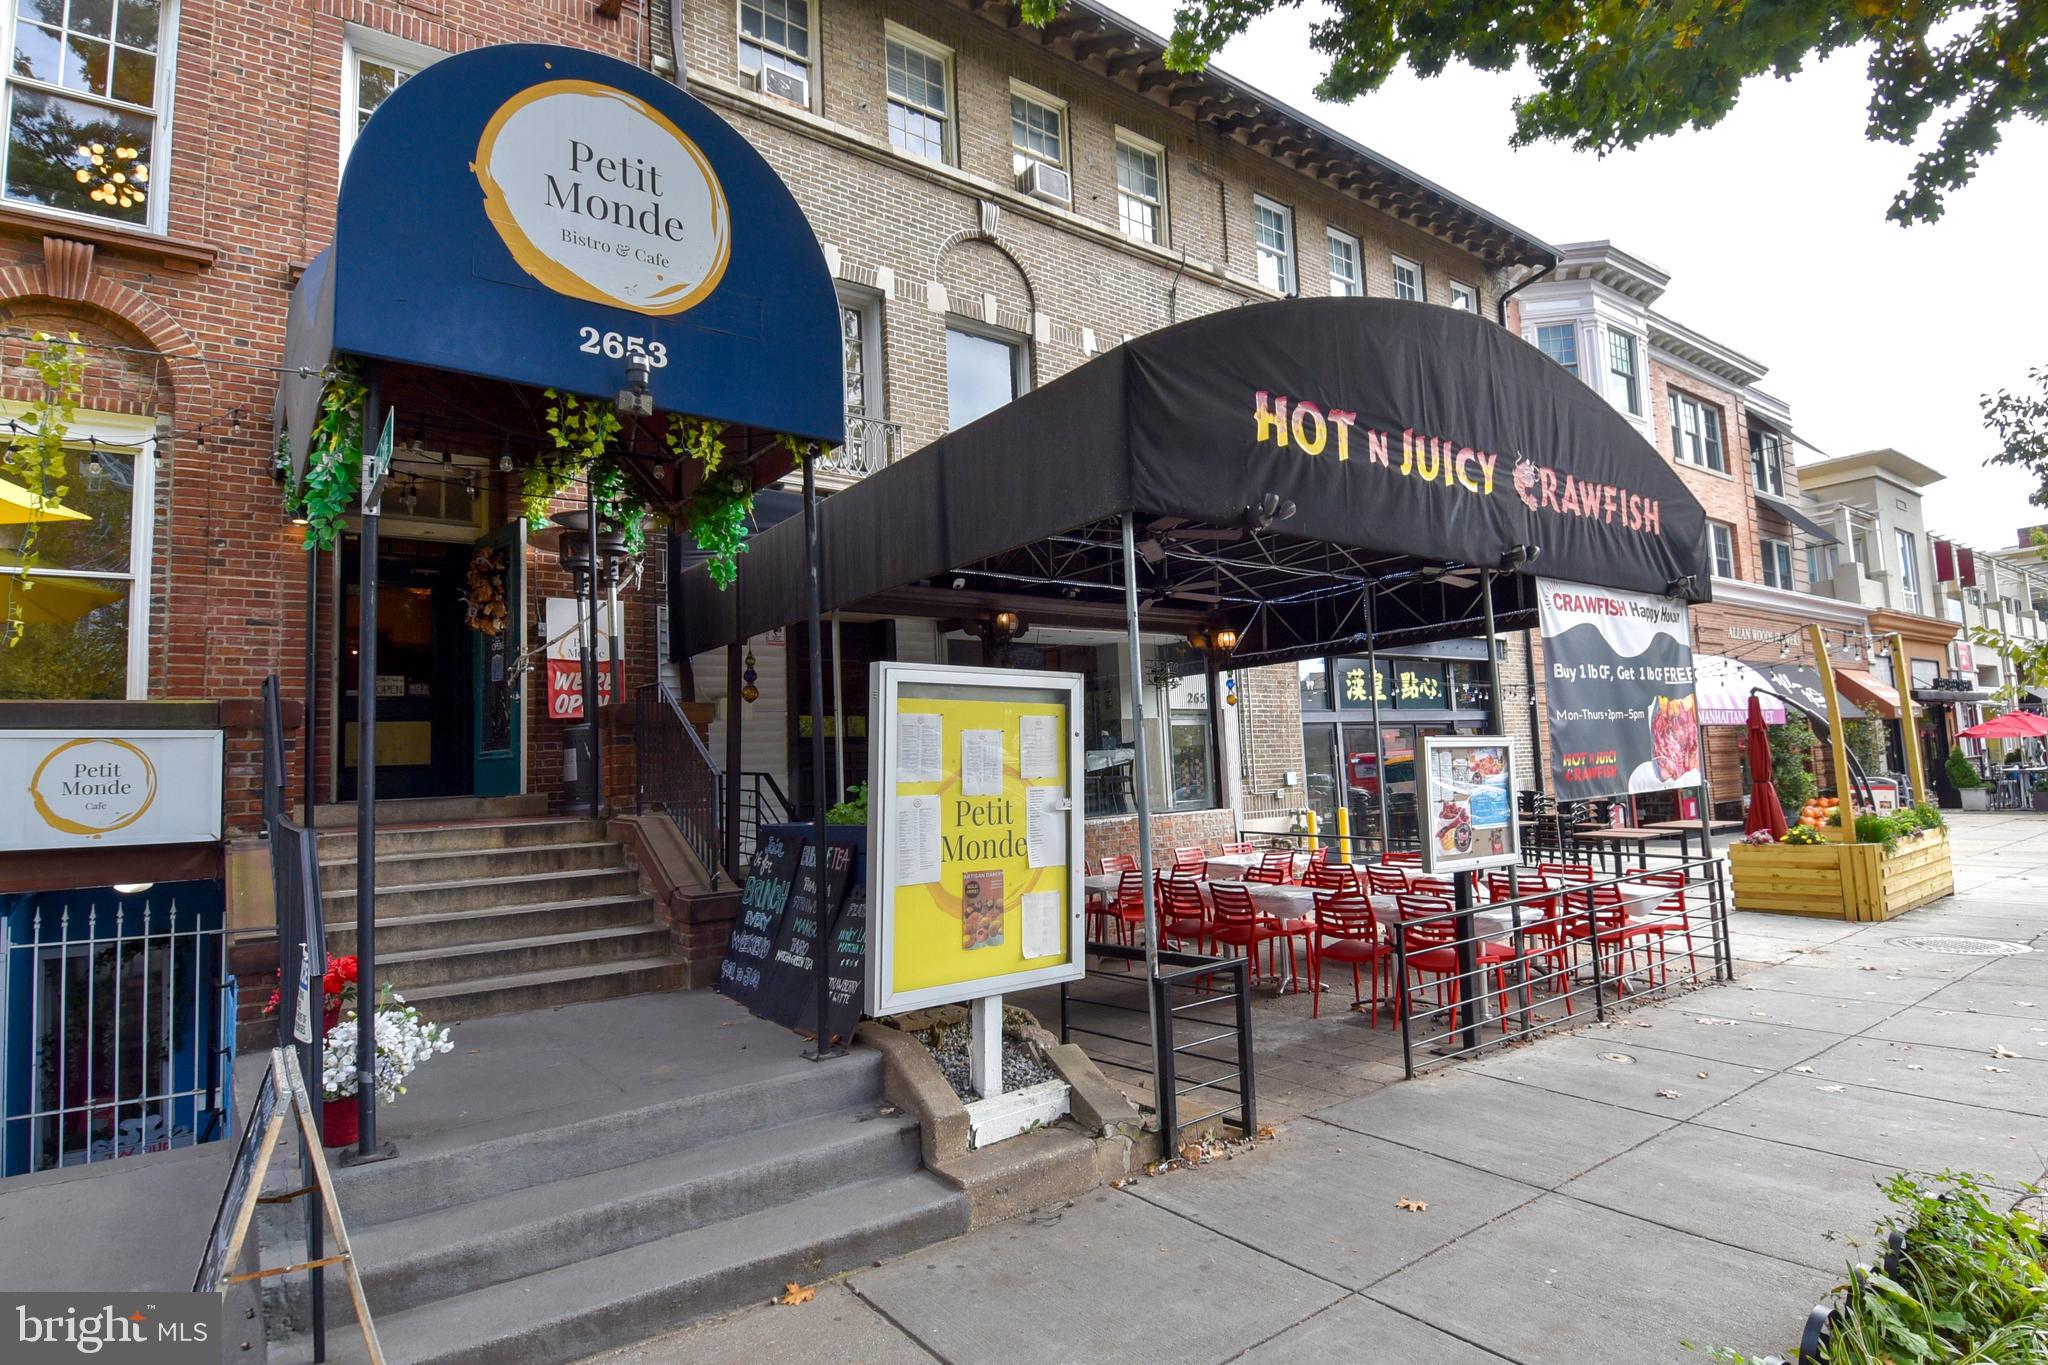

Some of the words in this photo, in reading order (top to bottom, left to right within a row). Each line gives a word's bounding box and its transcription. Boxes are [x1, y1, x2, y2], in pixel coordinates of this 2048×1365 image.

[568, 139, 664, 197] Petit
[544, 173, 684, 242] Monde
[561, 228, 611, 253] Bistro
[616, 244, 631, 257] &
[635, 249, 670, 268] Cafe
[580, 327, 668, 368] 2653
[1254, 390, 1358, 461] HOT
[1368, 428, 1389, 468] N
[1400, 427, 1497, 495] JUICY
[1512, 457, 1661, 535] CRAWFISH
[1553, 593, 1628, 617] CRAWFISH
[1629, 602, 1660, 624] Happy
[1660, 606, 1680, 623] Hour
[1728, 626, 1751, 640] ALLAN
[1553, 663, 1577, 682] Buy
[1616, 666, 1635, 680] Get
[1664, 666, 1693, 682] FREE
[554, 693, 610, 714] OPN
[74, 762, 121, 778] Petit
[1563, 752, 1587, 767] HOT
[62, 779, 131, 796] Monde
[85, 802, 107, 810] Cafe
[956, 797, 1014, 827] Petit
[832, 847, 849, 870] TEA
[941, 830, 1028, 862] Monde
[742, 876, 791, 914] BRUNCH
[744, 910, 772, 931] EVERY
